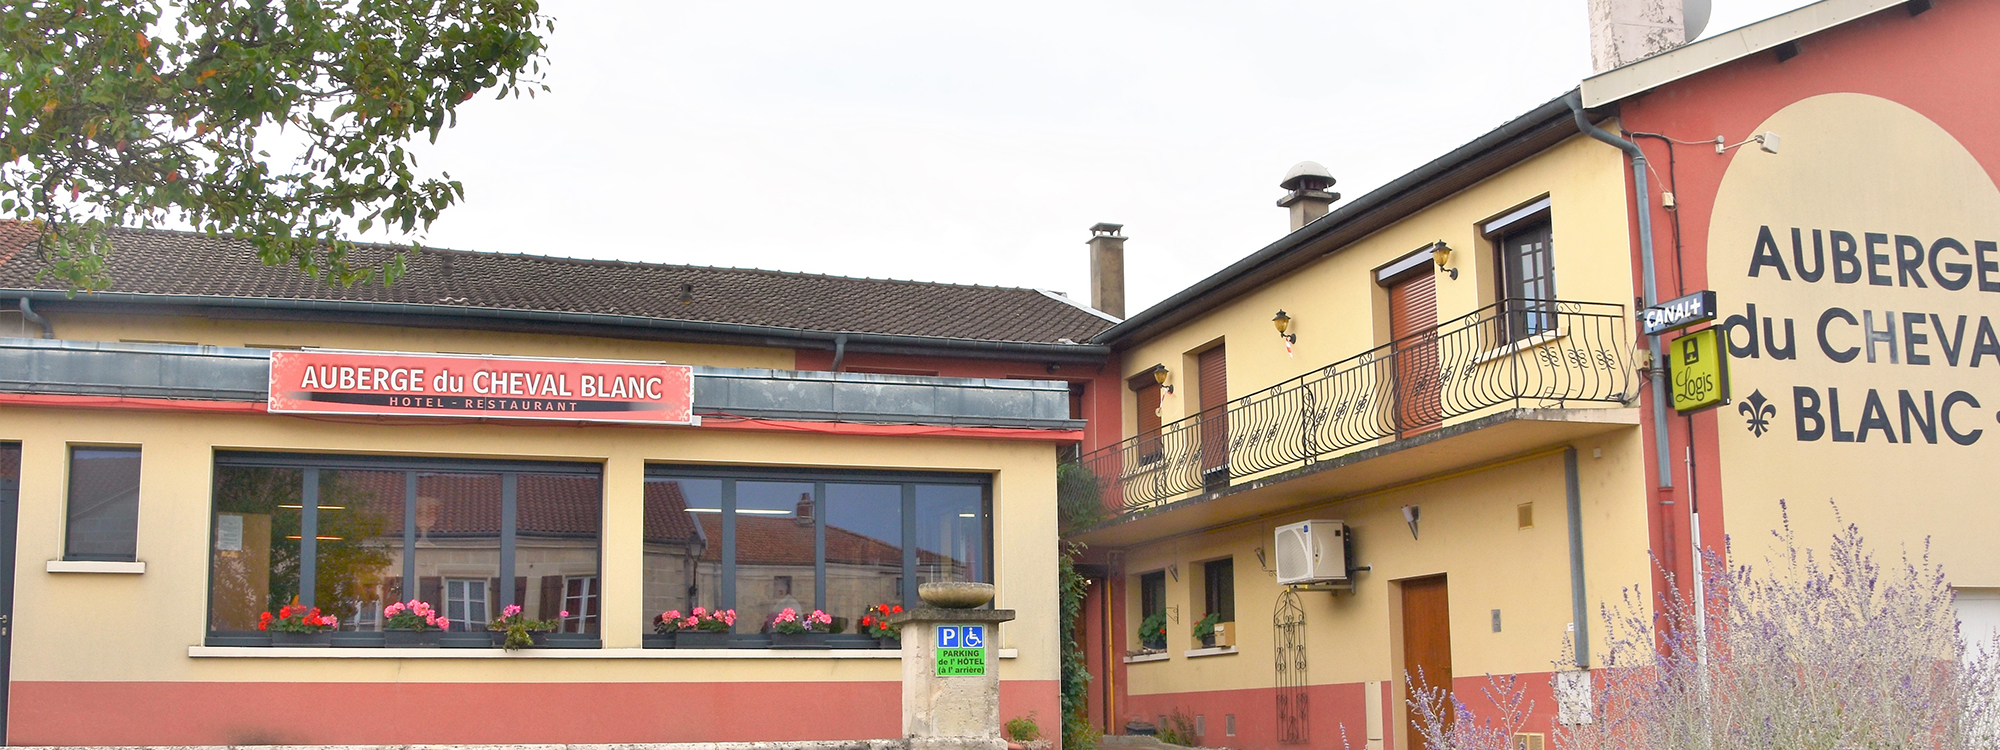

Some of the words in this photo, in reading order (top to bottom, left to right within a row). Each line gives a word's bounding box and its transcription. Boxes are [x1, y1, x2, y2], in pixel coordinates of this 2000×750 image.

[1748, 225, 2000, 292] AUBERGE
[1646, 298, 1701, 328] CANAL+
[1724, 303, 1796, 361] du
[301, 365, 424, 393] AUBERGE
[433, 369, 464, 394] du
[473, 371, 571, 397] CHEVAL
[580, 375, 662, 399] BLANC
[1675, 367, 1713, 403] Logis
[389, 397, 444, 408] HOTEL
[465, 399, 578, 412] RESTAURANT
[1793, 386, 1983, 446] BLANC
[943, 629, 955, 645] P
